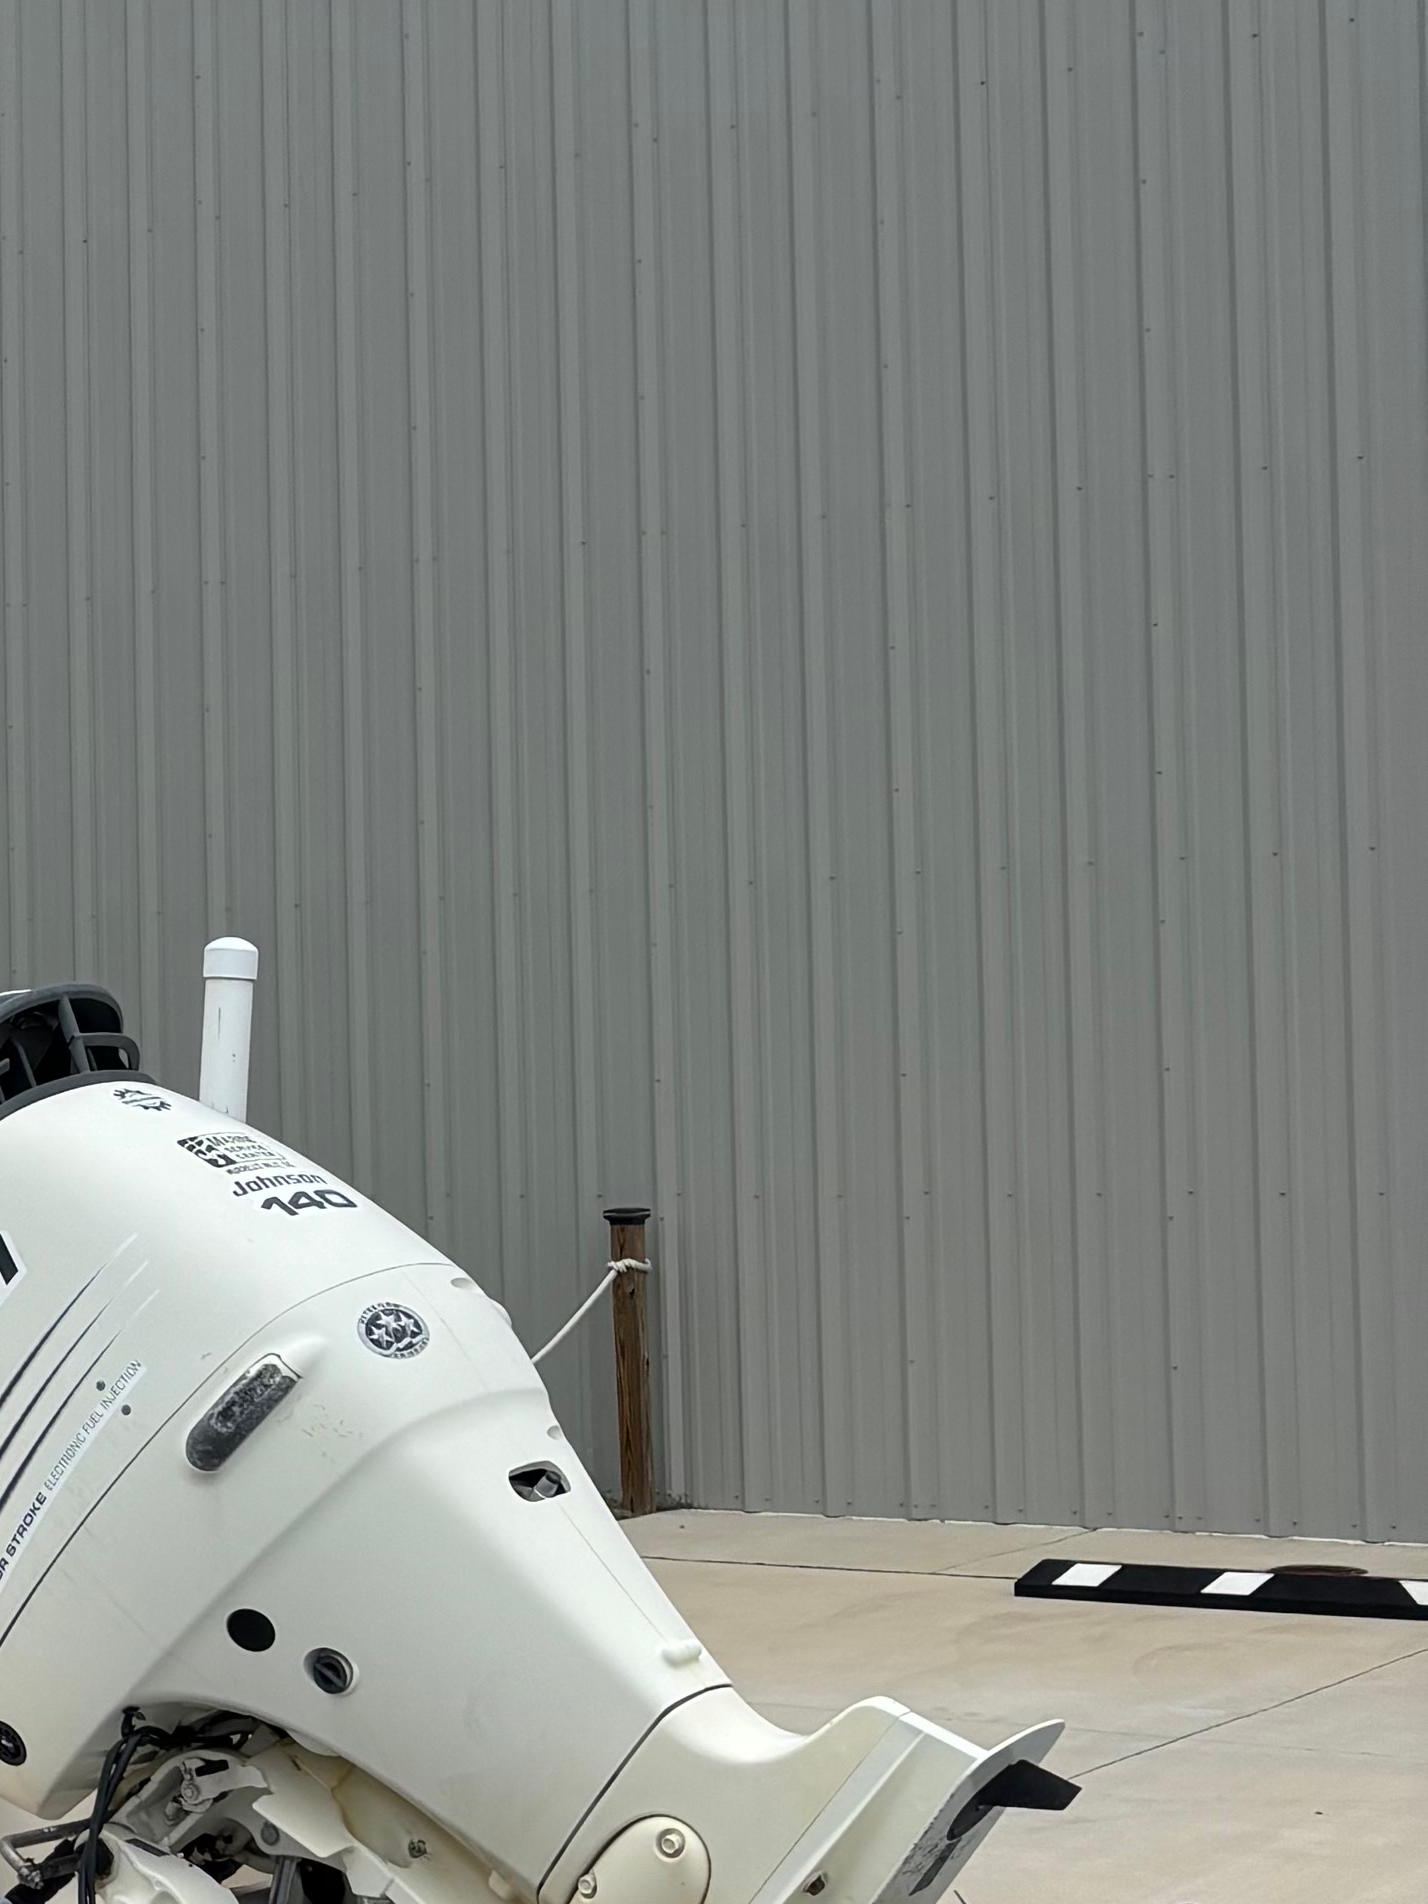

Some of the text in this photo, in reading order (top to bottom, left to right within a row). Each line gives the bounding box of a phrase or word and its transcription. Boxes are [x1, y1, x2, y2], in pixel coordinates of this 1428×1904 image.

[232, 1172, 328, 1197] Johnson
[260, 1189, 358, 1217] 140
[6, 1491, 47, 1558] STROKE
[44, 1433, 87, 1492] ELECTRONIC
[82, 1408, 104, 1438] FUEL
[99, 1359, 142, 1411] INJECTION
